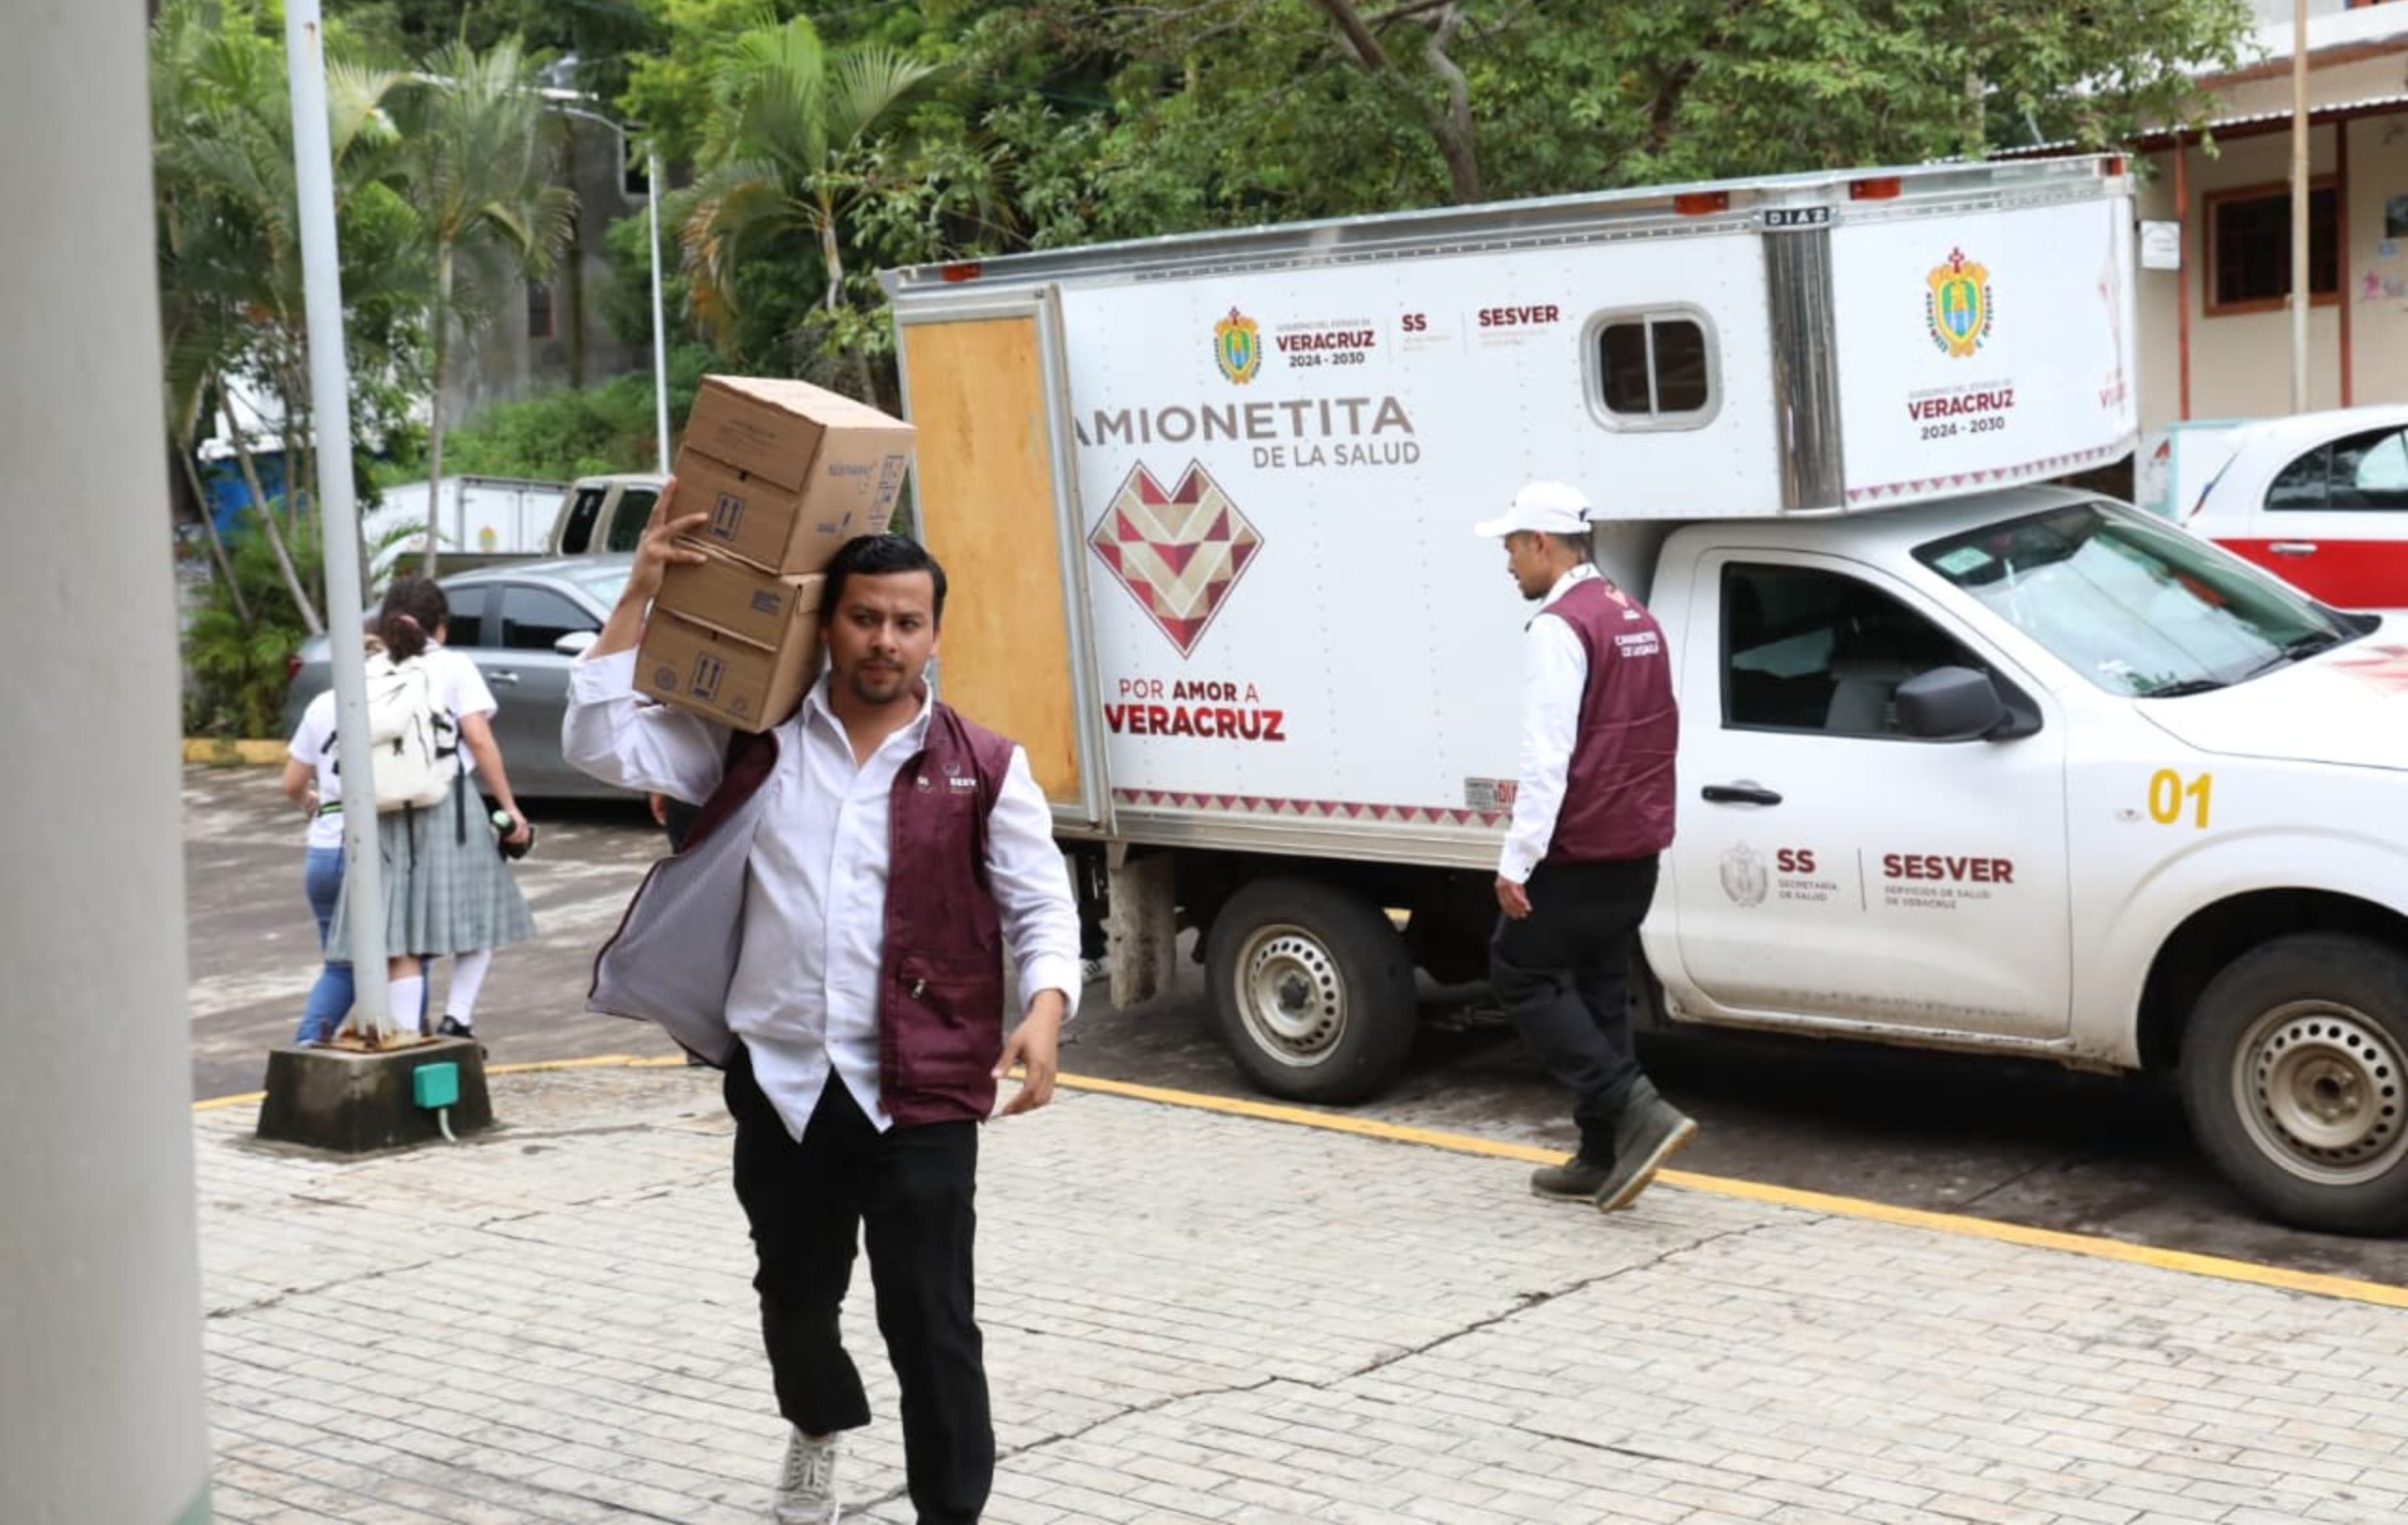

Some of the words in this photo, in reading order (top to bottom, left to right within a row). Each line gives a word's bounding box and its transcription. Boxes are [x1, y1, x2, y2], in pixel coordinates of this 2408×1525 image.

[1402, 312, 1427, 331] SS
[1478, 305, 1560, 327] SESVER
[1275, 330, 1376, 352] VERACRUZ
[1289, 354, 1322, 368] 2024
[1332, 351, 1366, 366] 2030
[1908, 389, 2014, 421] VERACRUZ
[1921, 423, 1957, 441] 2024
[1970, 416, 2005, 434] 2030
[1253, 446, 1285, 469] DE
[1293, 444, 1326, 468] LA
[1333, 441, 1421, 466] SALUD
[1119, 678, 1164, 700] POR
[1172, 679, 1238, 703] AMOR
[1244, 683, 1259, 704] A
[1104, 703, 1286, 741] VERACRUZ
[2148, 768, 2211, 829] 01
[1777, 848, 1816, 874] SS
[1883, 853, 2015, 884] SESVER
